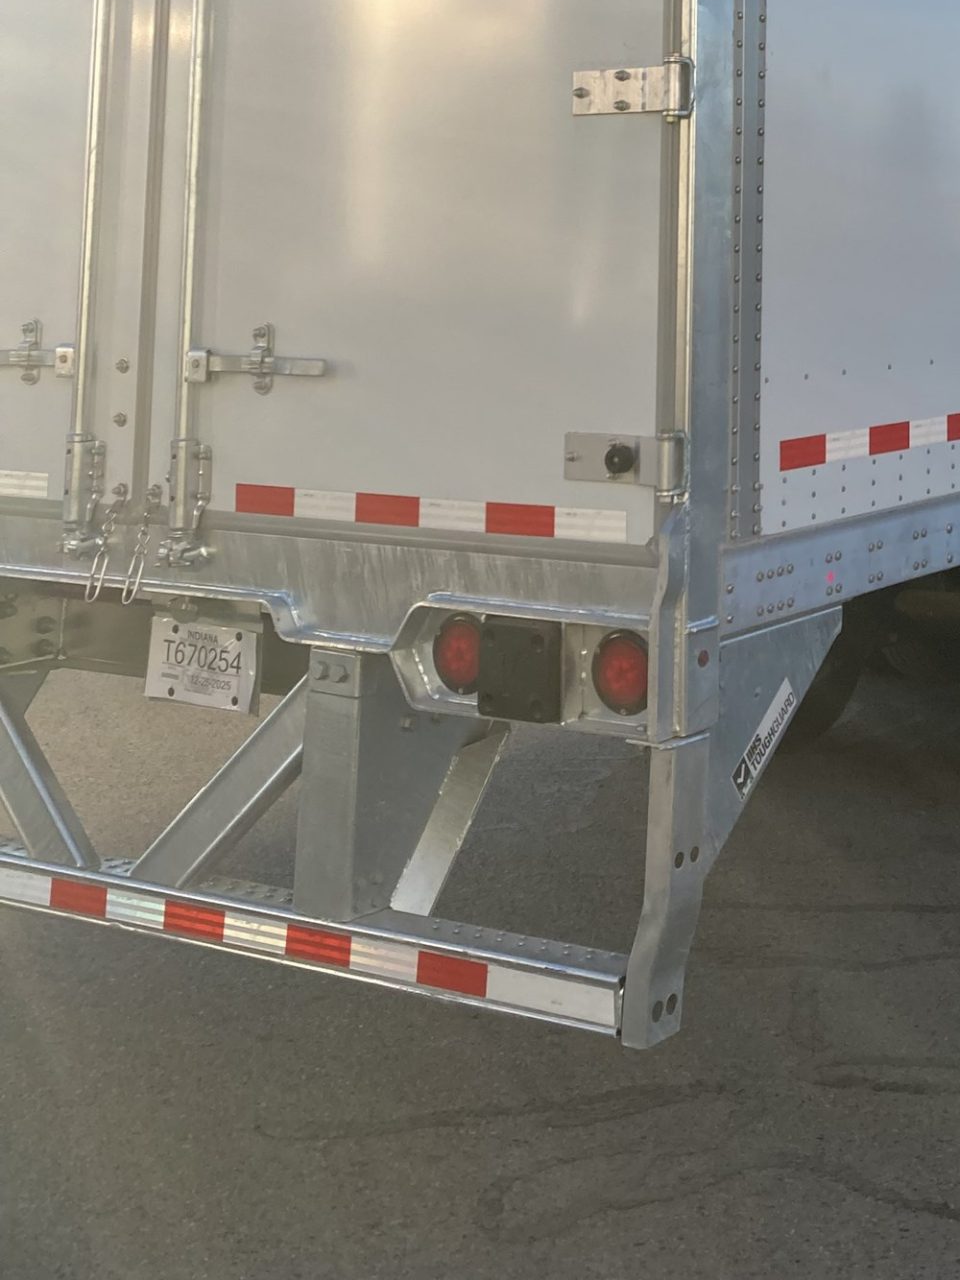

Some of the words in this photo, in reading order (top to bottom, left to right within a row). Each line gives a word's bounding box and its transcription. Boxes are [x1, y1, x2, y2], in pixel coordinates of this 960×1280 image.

[187, 630, 218, 645] INDIANA
[163, 639, 242, 675] T670254
[750, 691, 795, 772] TOUGHGUARD
